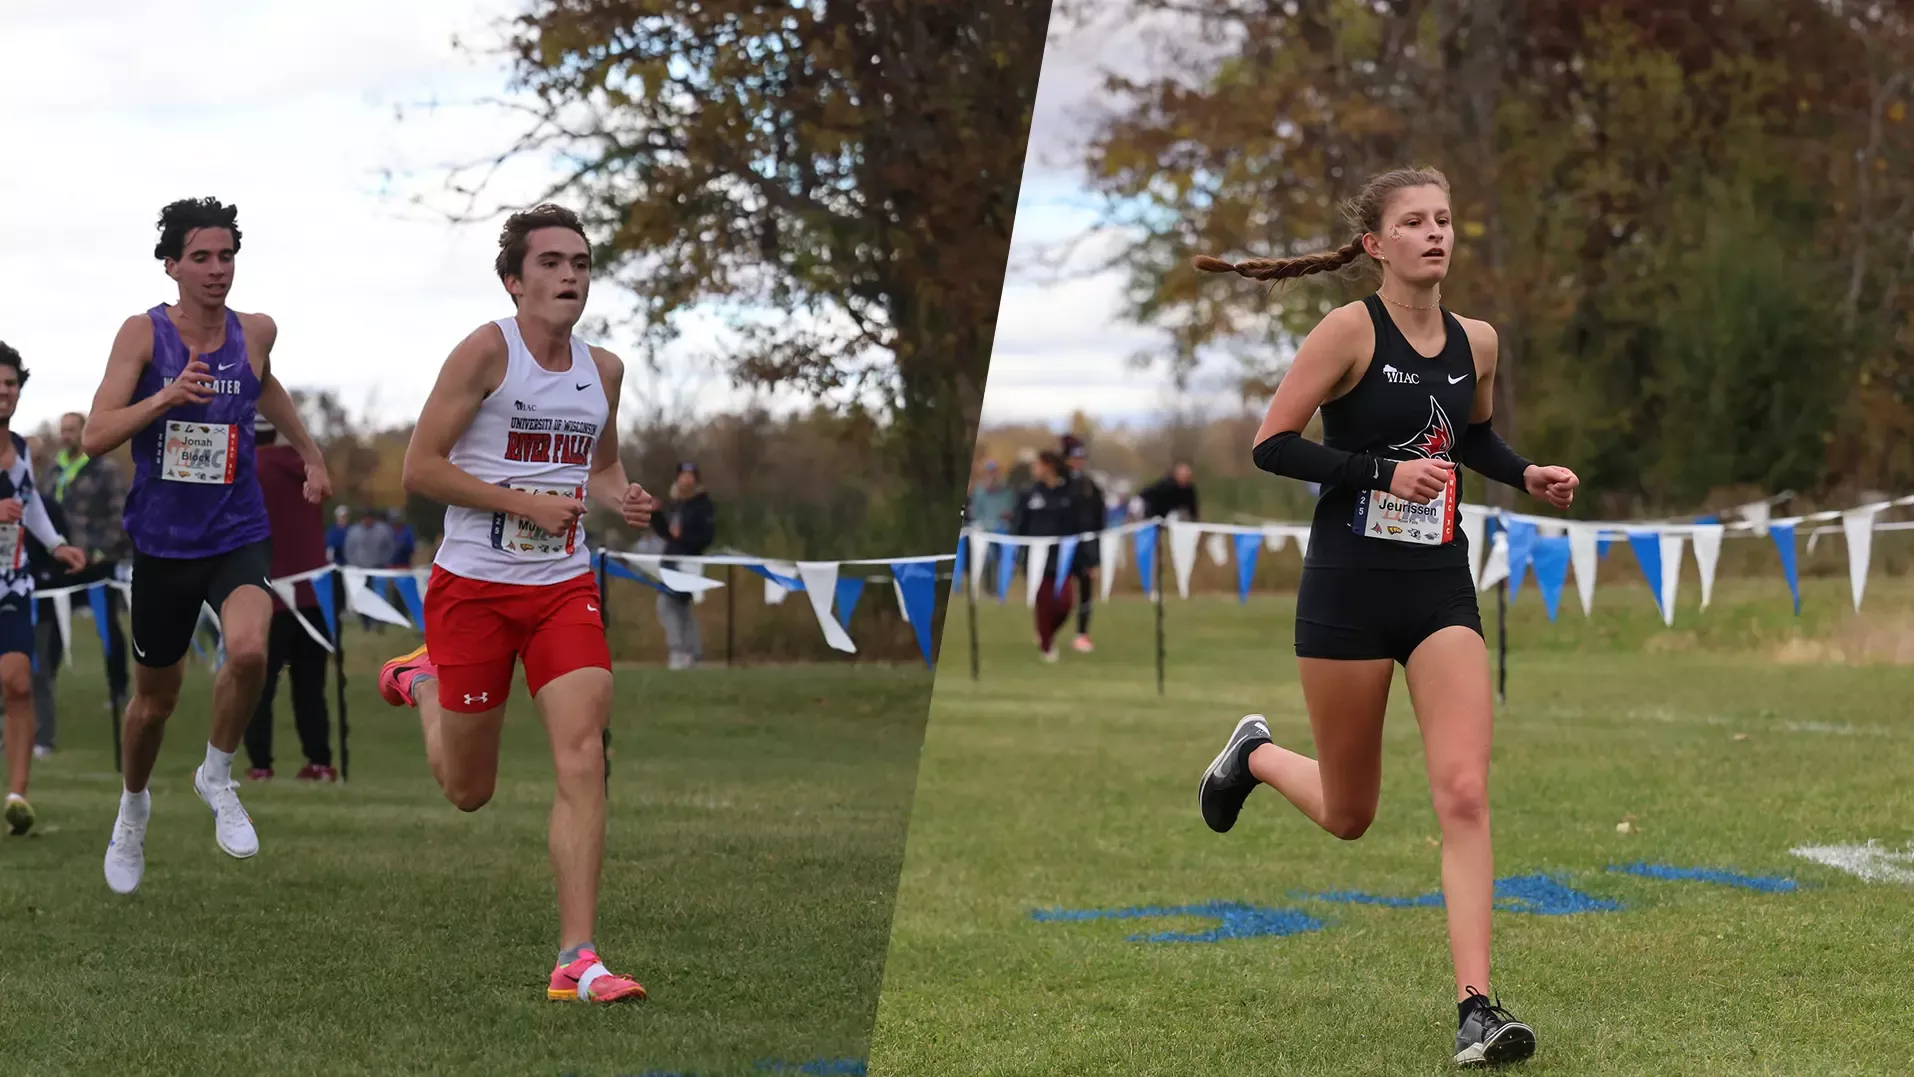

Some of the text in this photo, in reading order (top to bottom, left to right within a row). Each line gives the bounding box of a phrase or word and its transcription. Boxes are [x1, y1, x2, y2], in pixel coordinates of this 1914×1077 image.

[1384, 369, 1420, 385] WIAC
[515, 402, 537, 411] WIAC
[511, 417, 598, 436] UNIVERSITY OF WISCONSIN
[181, 437, 213, 447] Jonah
[504, 431, 552, 463] RIVER
[181, 451, 210, 462] Block
[1379, 499, 1437, 516] Jeurissen
[1446, 519, 1451, 534] XC
